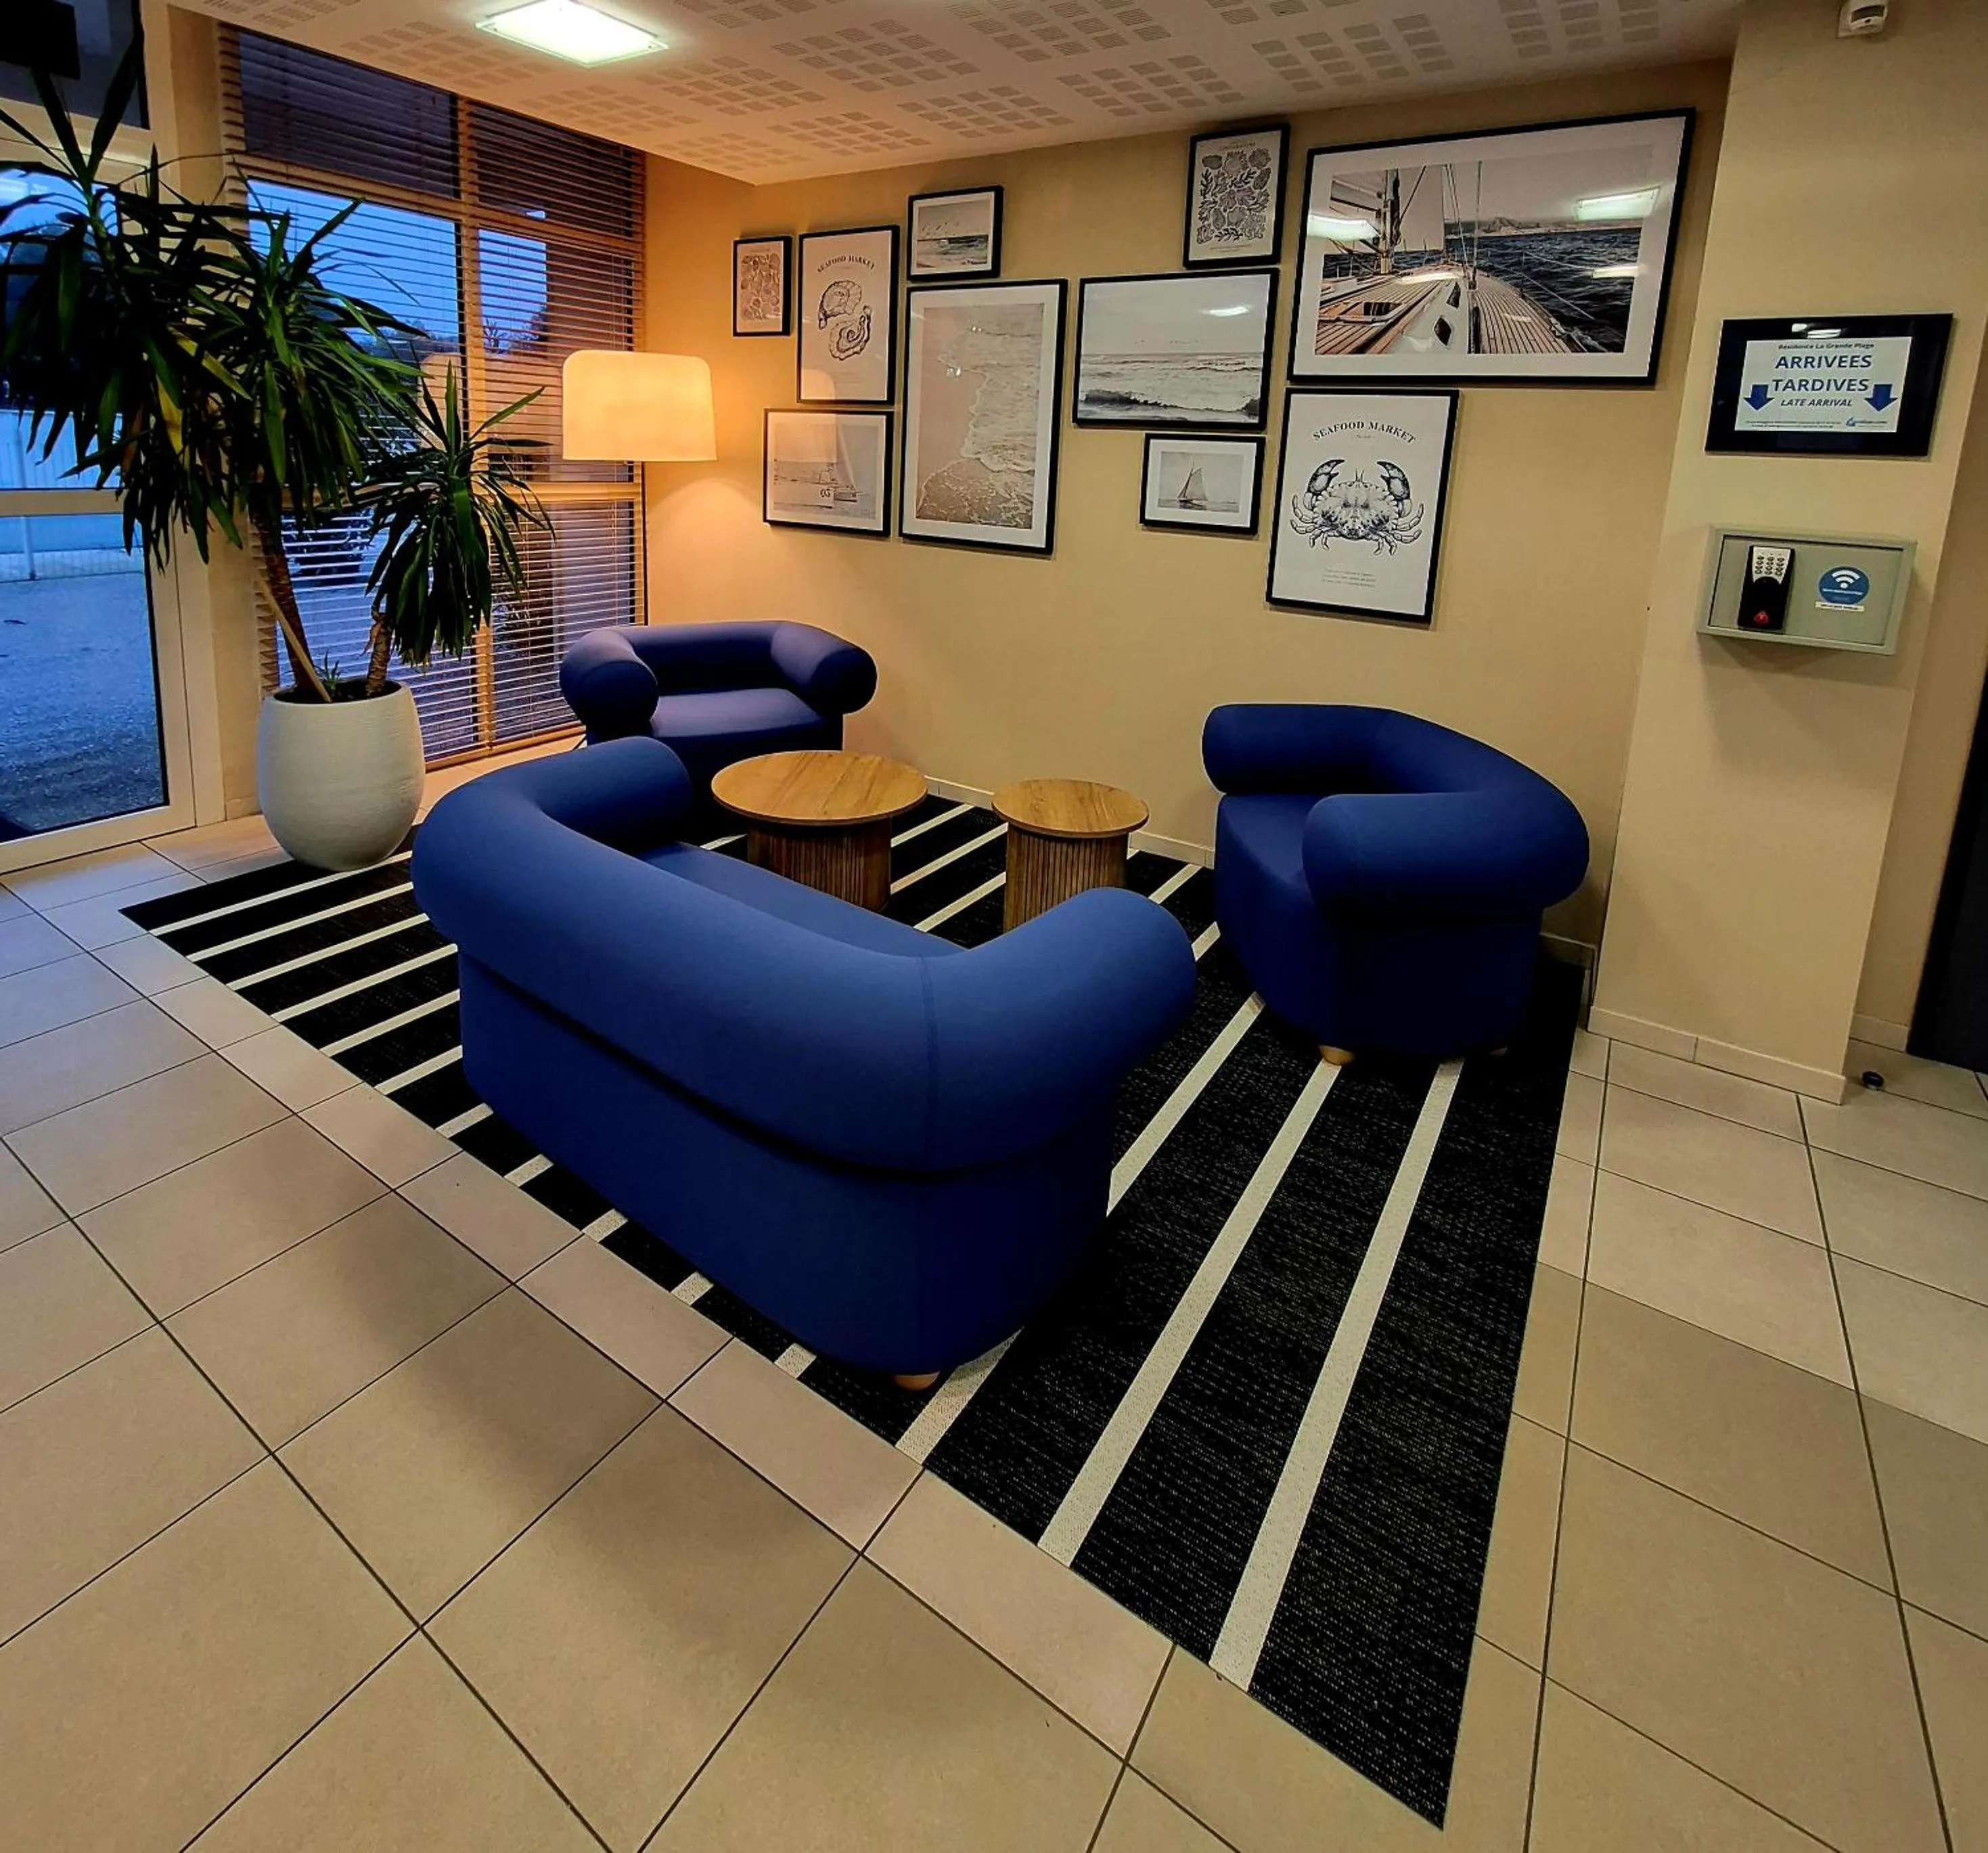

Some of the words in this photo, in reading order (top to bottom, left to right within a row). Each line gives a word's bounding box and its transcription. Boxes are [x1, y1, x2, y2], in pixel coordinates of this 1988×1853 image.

[1854, 342, 1875, 350] Plage
[1775, 355, 1872, 369] ARRIVEES
[1772, 378, 1870, 392] TARDIVES
[1781, 398, 1807, 407] LATE
[1807, 398, 1853, 407] ARRIVAL
[1313, 421, 1365, 441] SEAFOOD
[1368, 421, 1416, 443] MARKET
